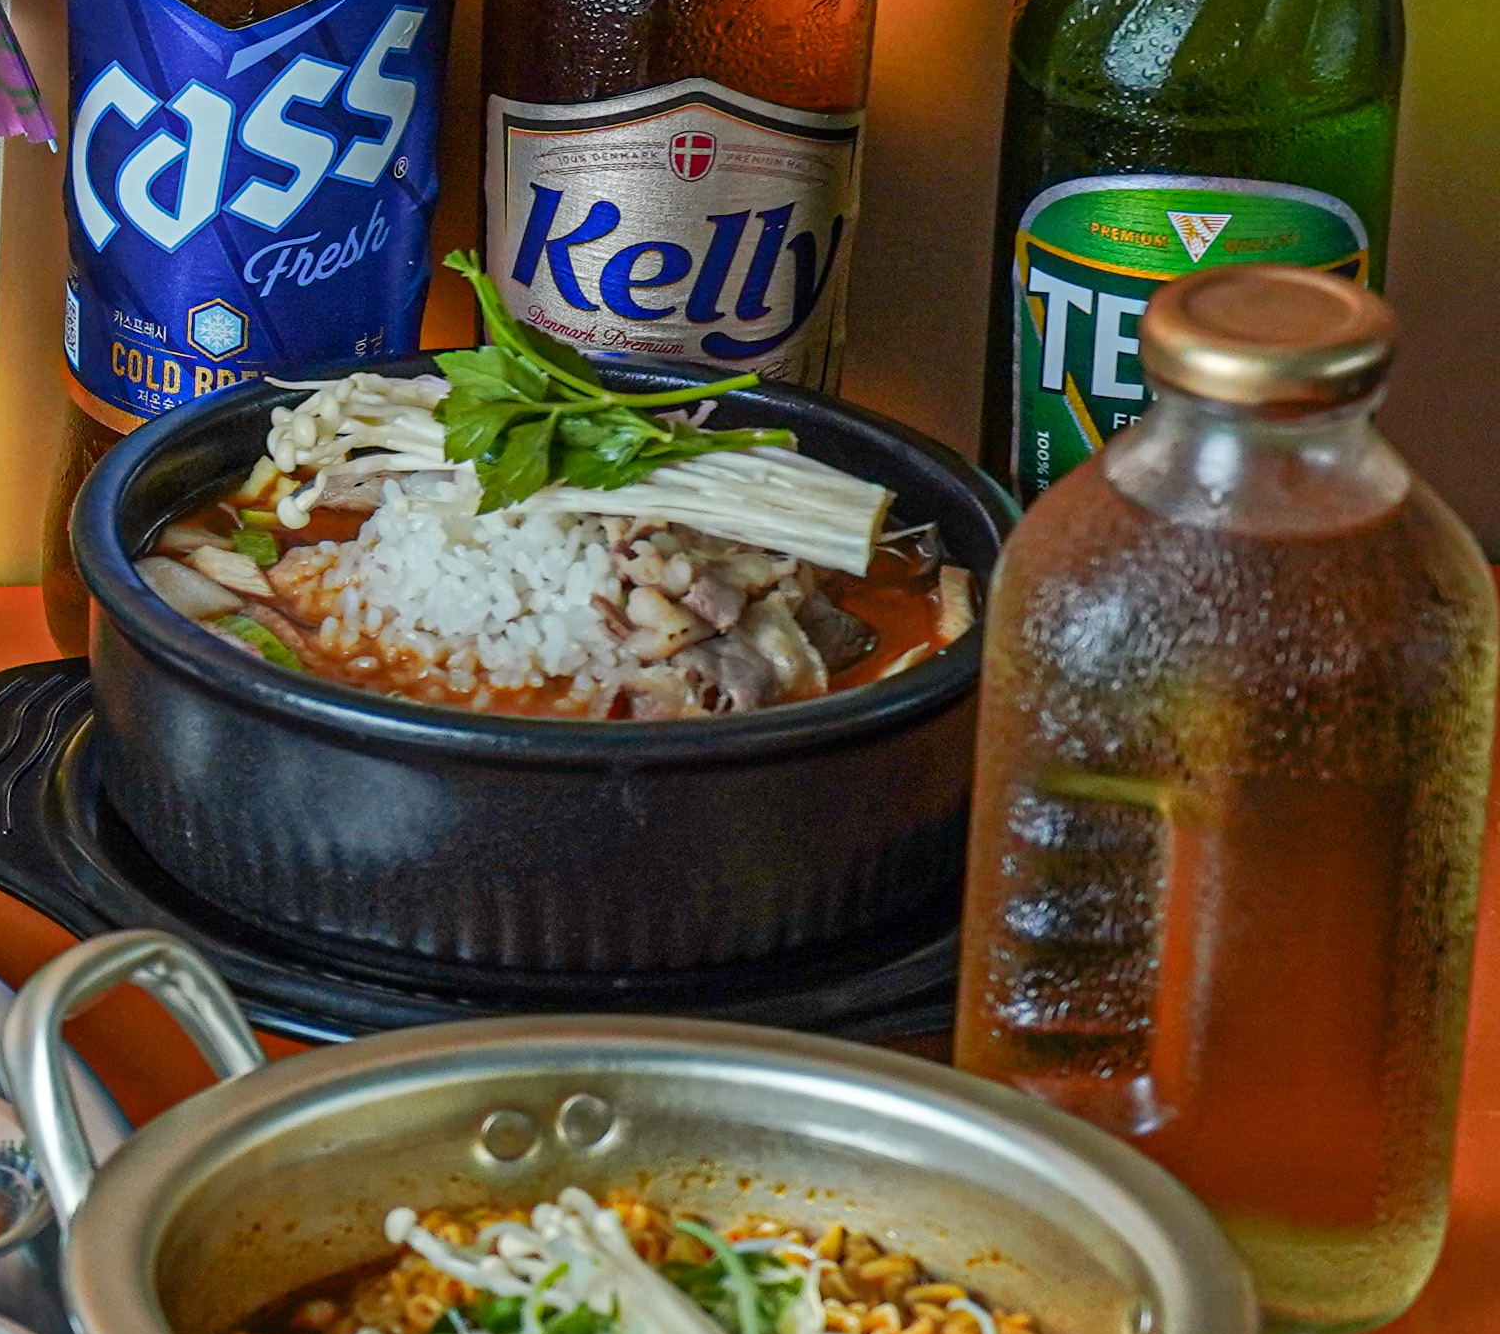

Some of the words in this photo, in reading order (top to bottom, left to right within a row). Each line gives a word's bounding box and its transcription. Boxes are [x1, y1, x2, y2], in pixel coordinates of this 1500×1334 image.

[243, 200, 390, 298] Fresh
[1090, 222, 1169, 248] PREMIUM
[512, 182, 843, 360] Kelly
[113, 310, 167, 343] 카스프레시
[527, 304, 596, 344] Denmark
[602, 328, 684, 355] Premium
[112, 341, 182, 394] COLD
[1037, 431, 1049, 475] 100%
